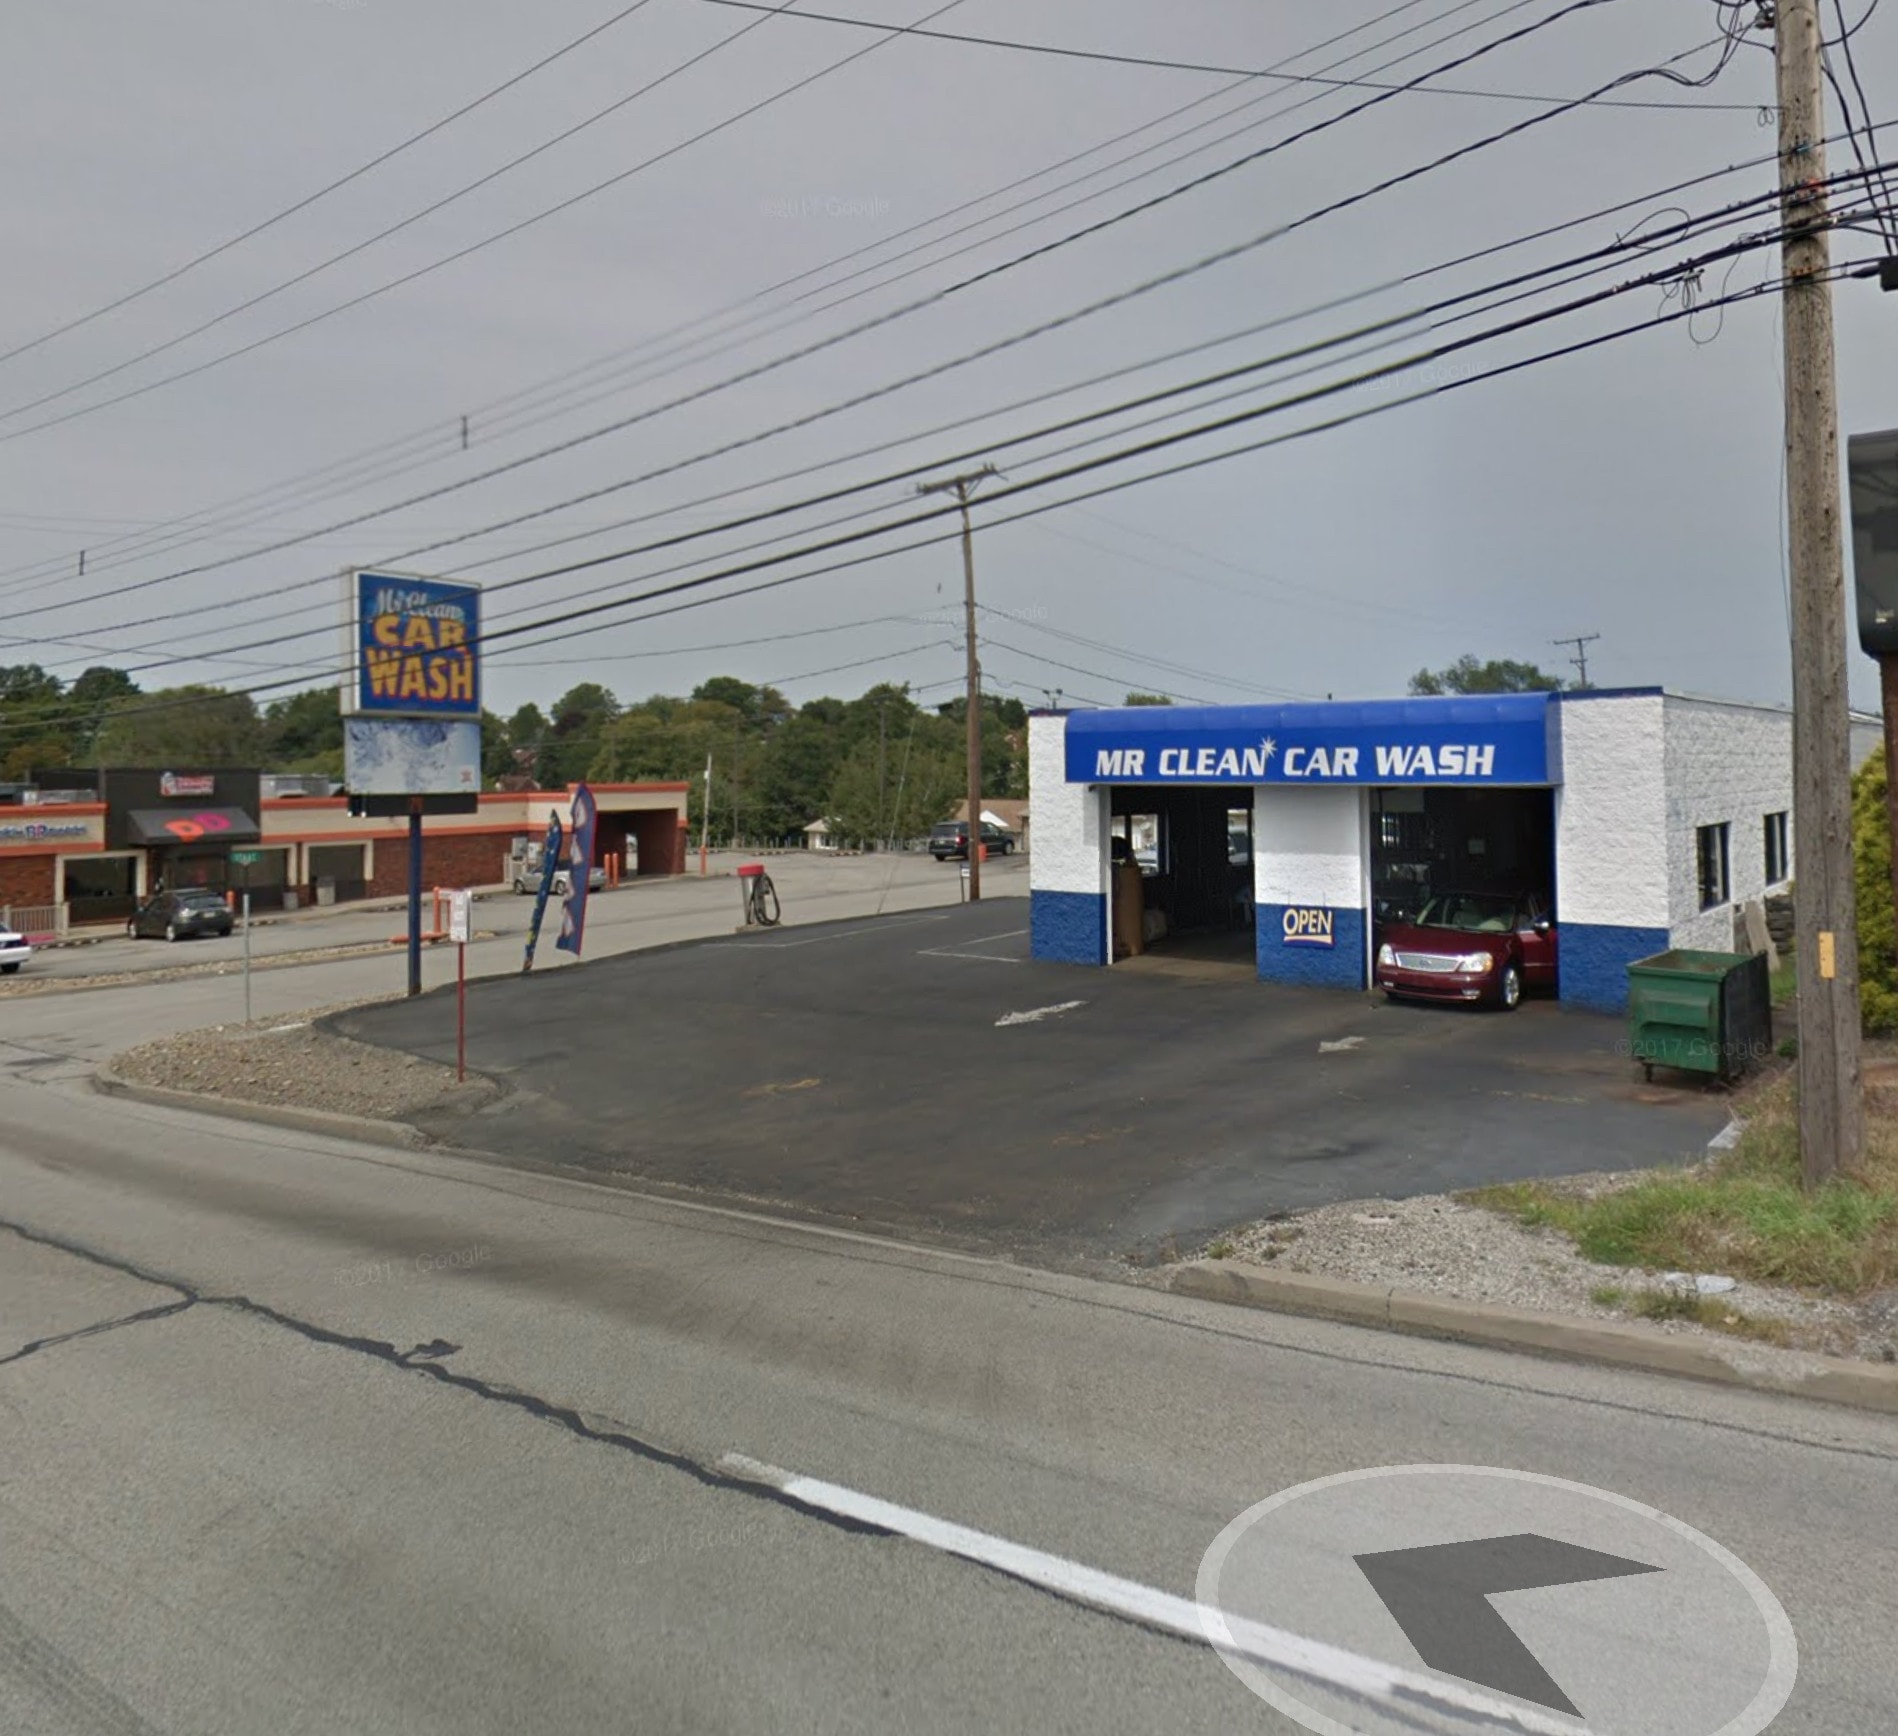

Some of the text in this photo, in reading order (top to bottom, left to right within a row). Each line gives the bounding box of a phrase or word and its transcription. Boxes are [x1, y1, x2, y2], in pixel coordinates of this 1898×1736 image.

[373, 614, 470, 654] CAR
[366, 647, 474, 701] WASH
[1096, 744, 1496, 776] MR CLEAN CAR WASH
[1283, 908, 1332, 935] OPEN
